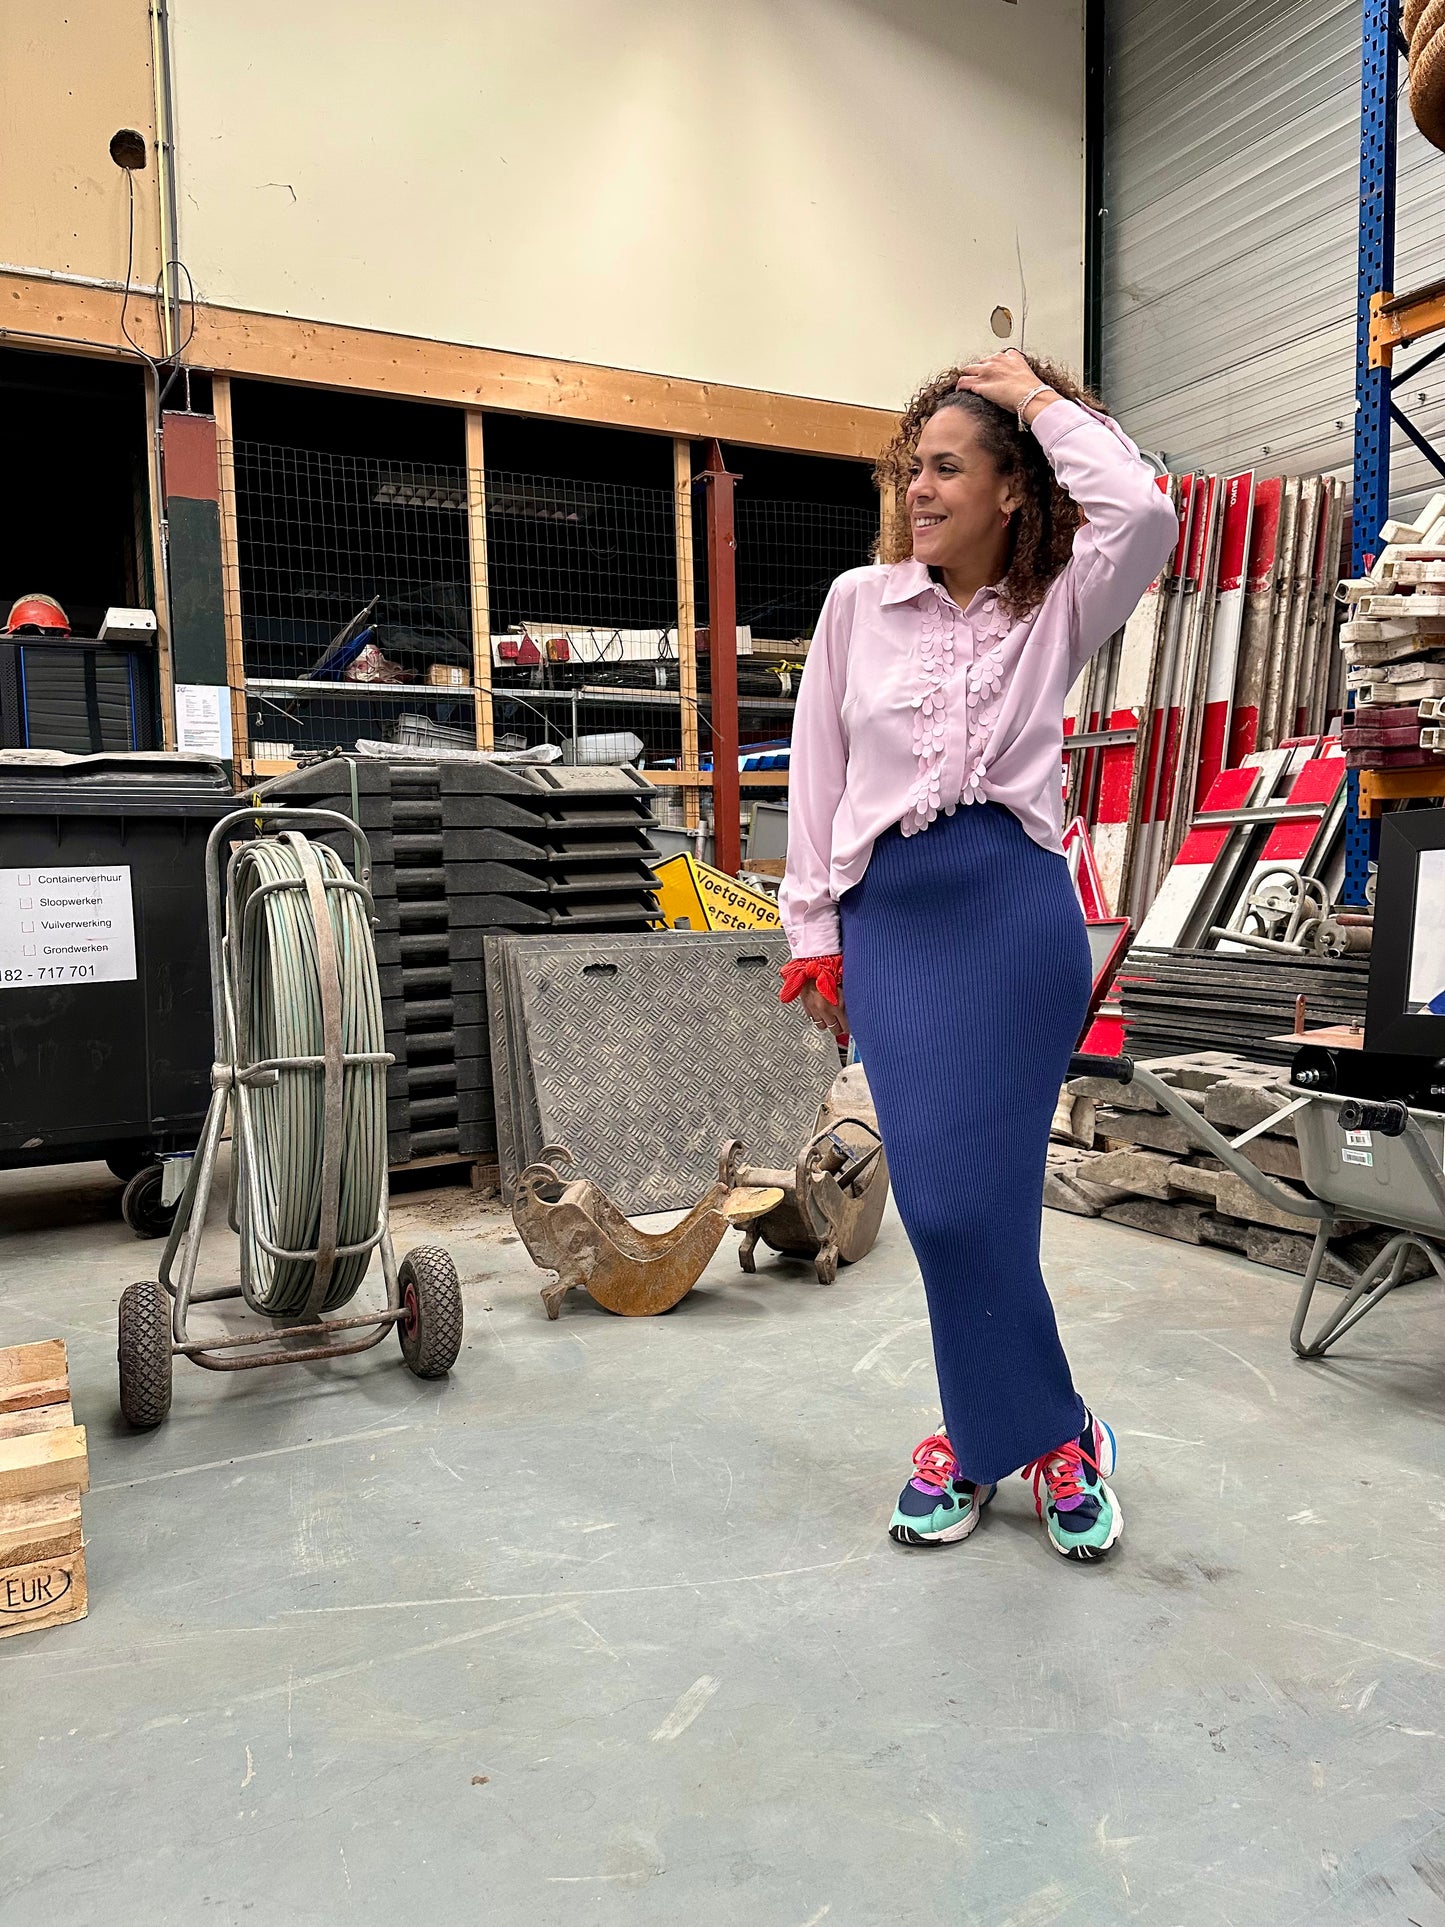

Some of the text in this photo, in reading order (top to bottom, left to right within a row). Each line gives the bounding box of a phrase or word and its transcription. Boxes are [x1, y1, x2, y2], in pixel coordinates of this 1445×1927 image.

[38, 873, 122, 885] Containerverhuur
[39, 896, 103, 907] Sloopwerken
[697, 871, 784, 928] Voetganger
[41, 918, 112, 930] Vuilverwerking
[43, 943, 109, 955] Grondwerken
[37, 966, 65, 980] 717
[69, 964, 95, 978] 701
[6, 1574, 53, 1607] EUR
